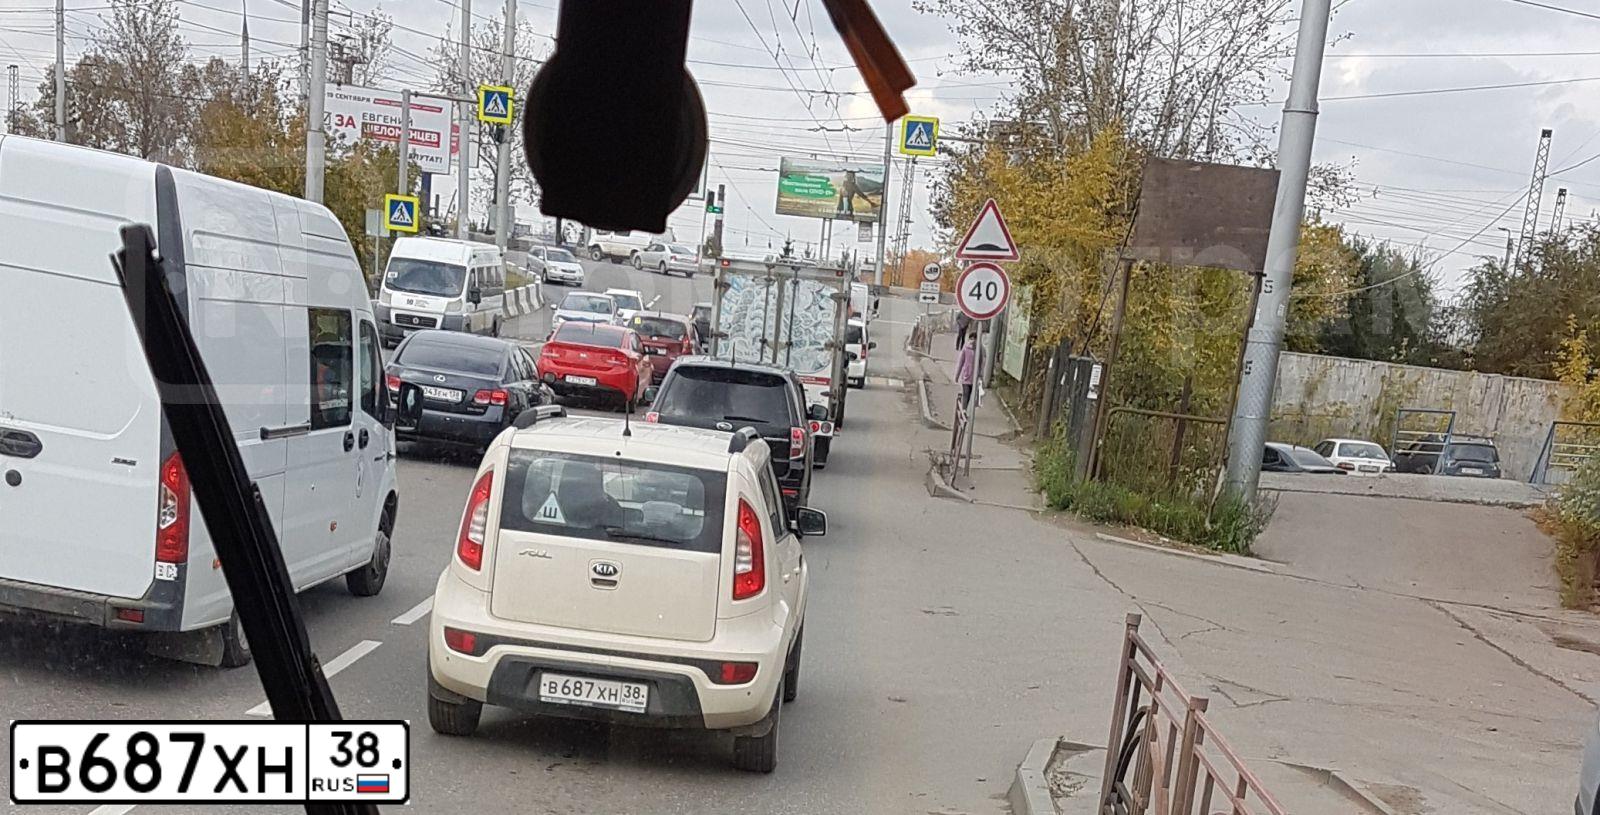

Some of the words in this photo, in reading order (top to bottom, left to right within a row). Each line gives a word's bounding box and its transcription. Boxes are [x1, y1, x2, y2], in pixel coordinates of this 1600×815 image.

[335, 94, 371, 103] СЕНТЯБРЯ
[335, 113, 356, 129] ЗА
[969, 281, 998, 301] 40
[543, 505, 558, 519] Ш
[594, 564, 614, 575] KIA
